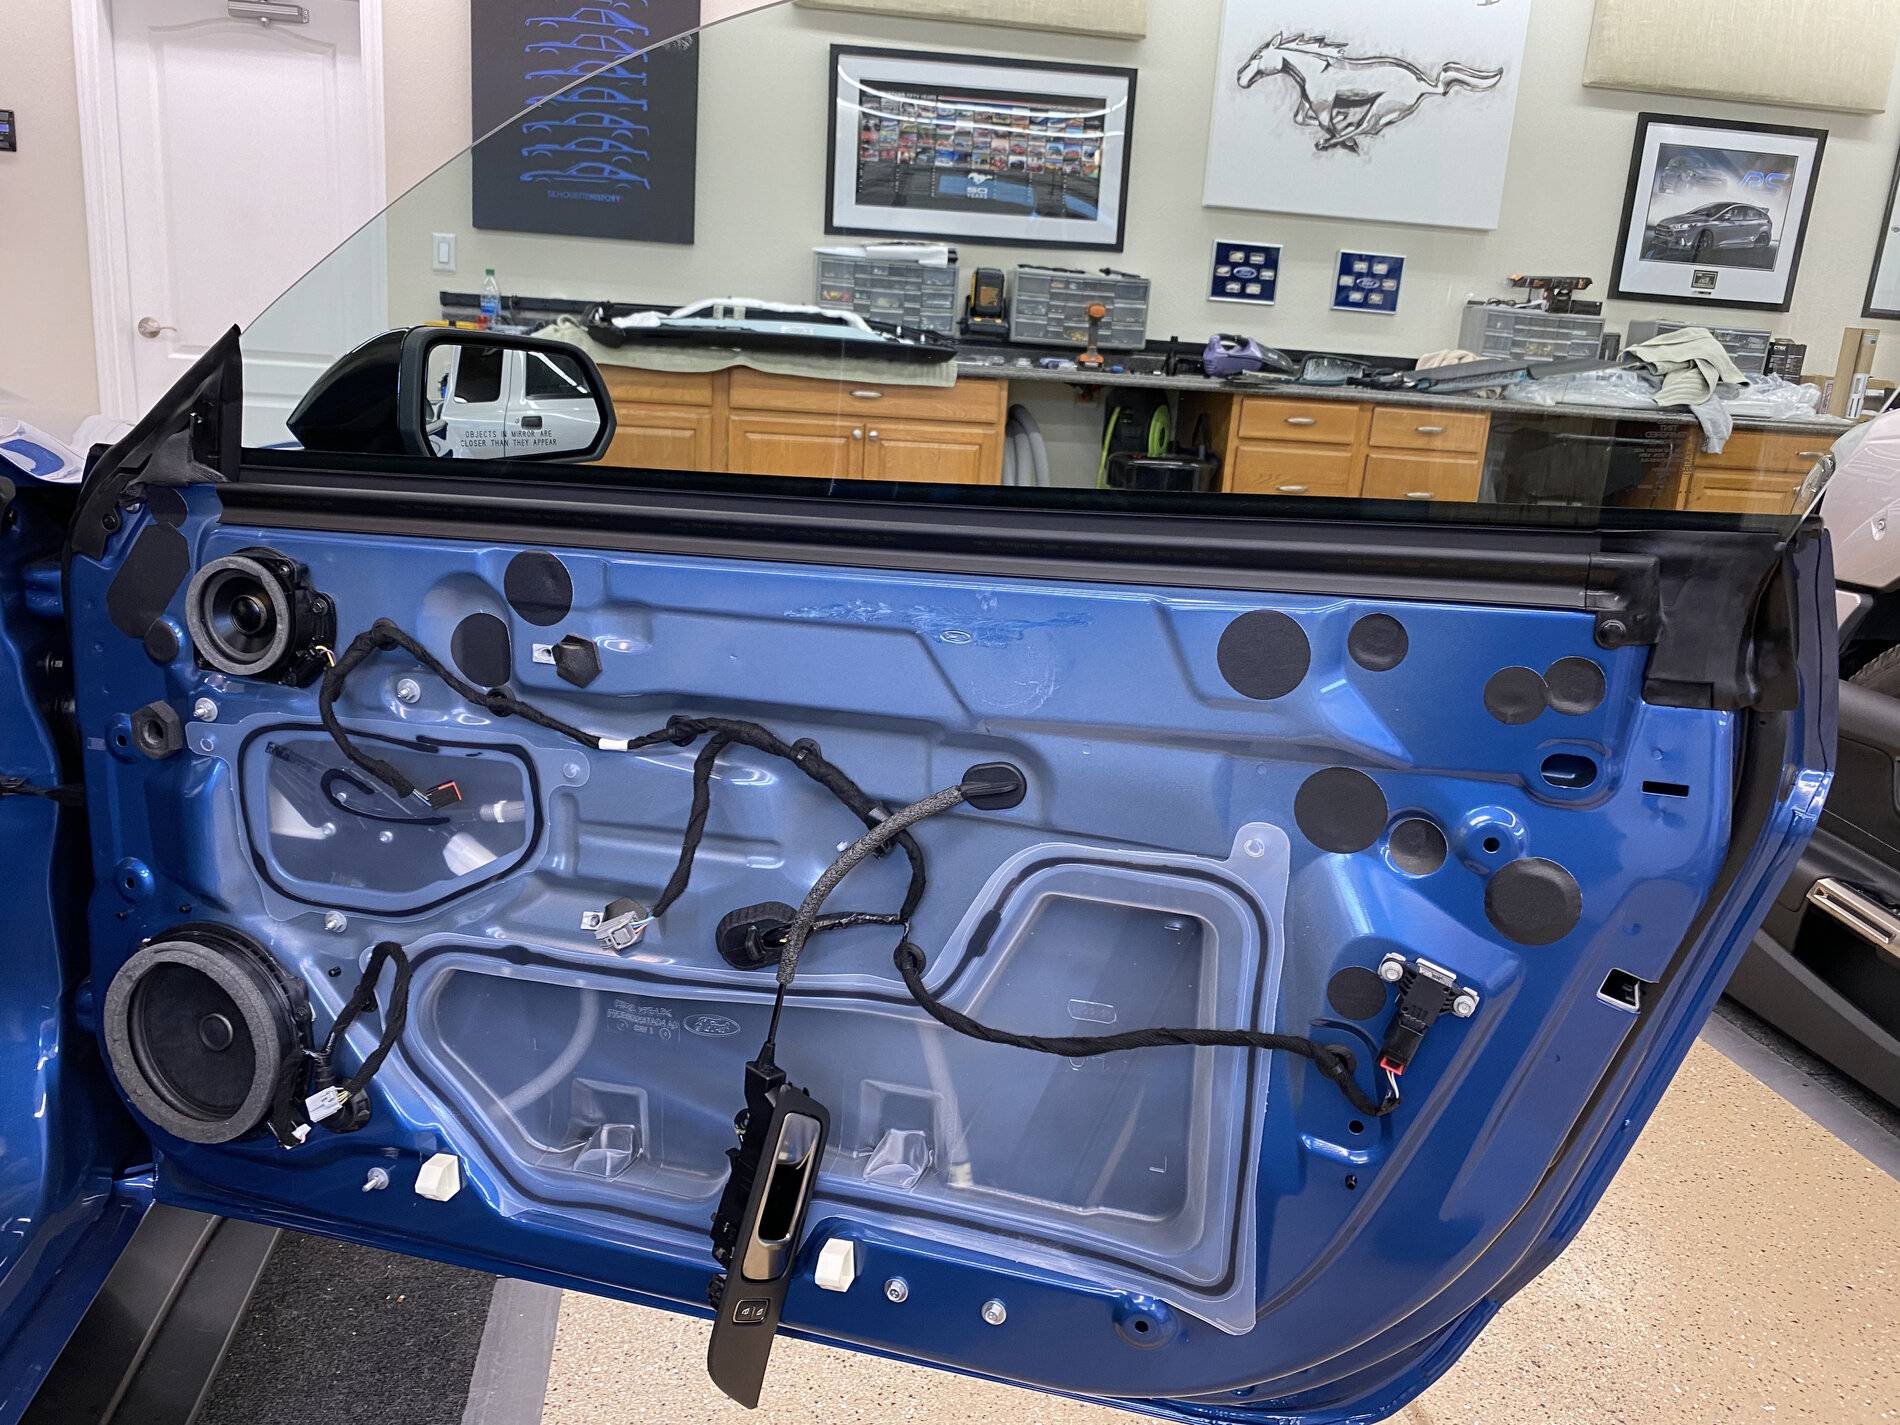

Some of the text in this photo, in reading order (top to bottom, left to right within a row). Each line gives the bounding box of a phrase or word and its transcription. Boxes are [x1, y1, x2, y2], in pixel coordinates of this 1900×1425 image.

[465, 430, 497, 438] OBJECTS
[511, 430, 536, 438] MIRROR
[540, 429, 553, 438] ARE
[460, 438, 557, 447] CLOSER THAN THEY APPEAR
